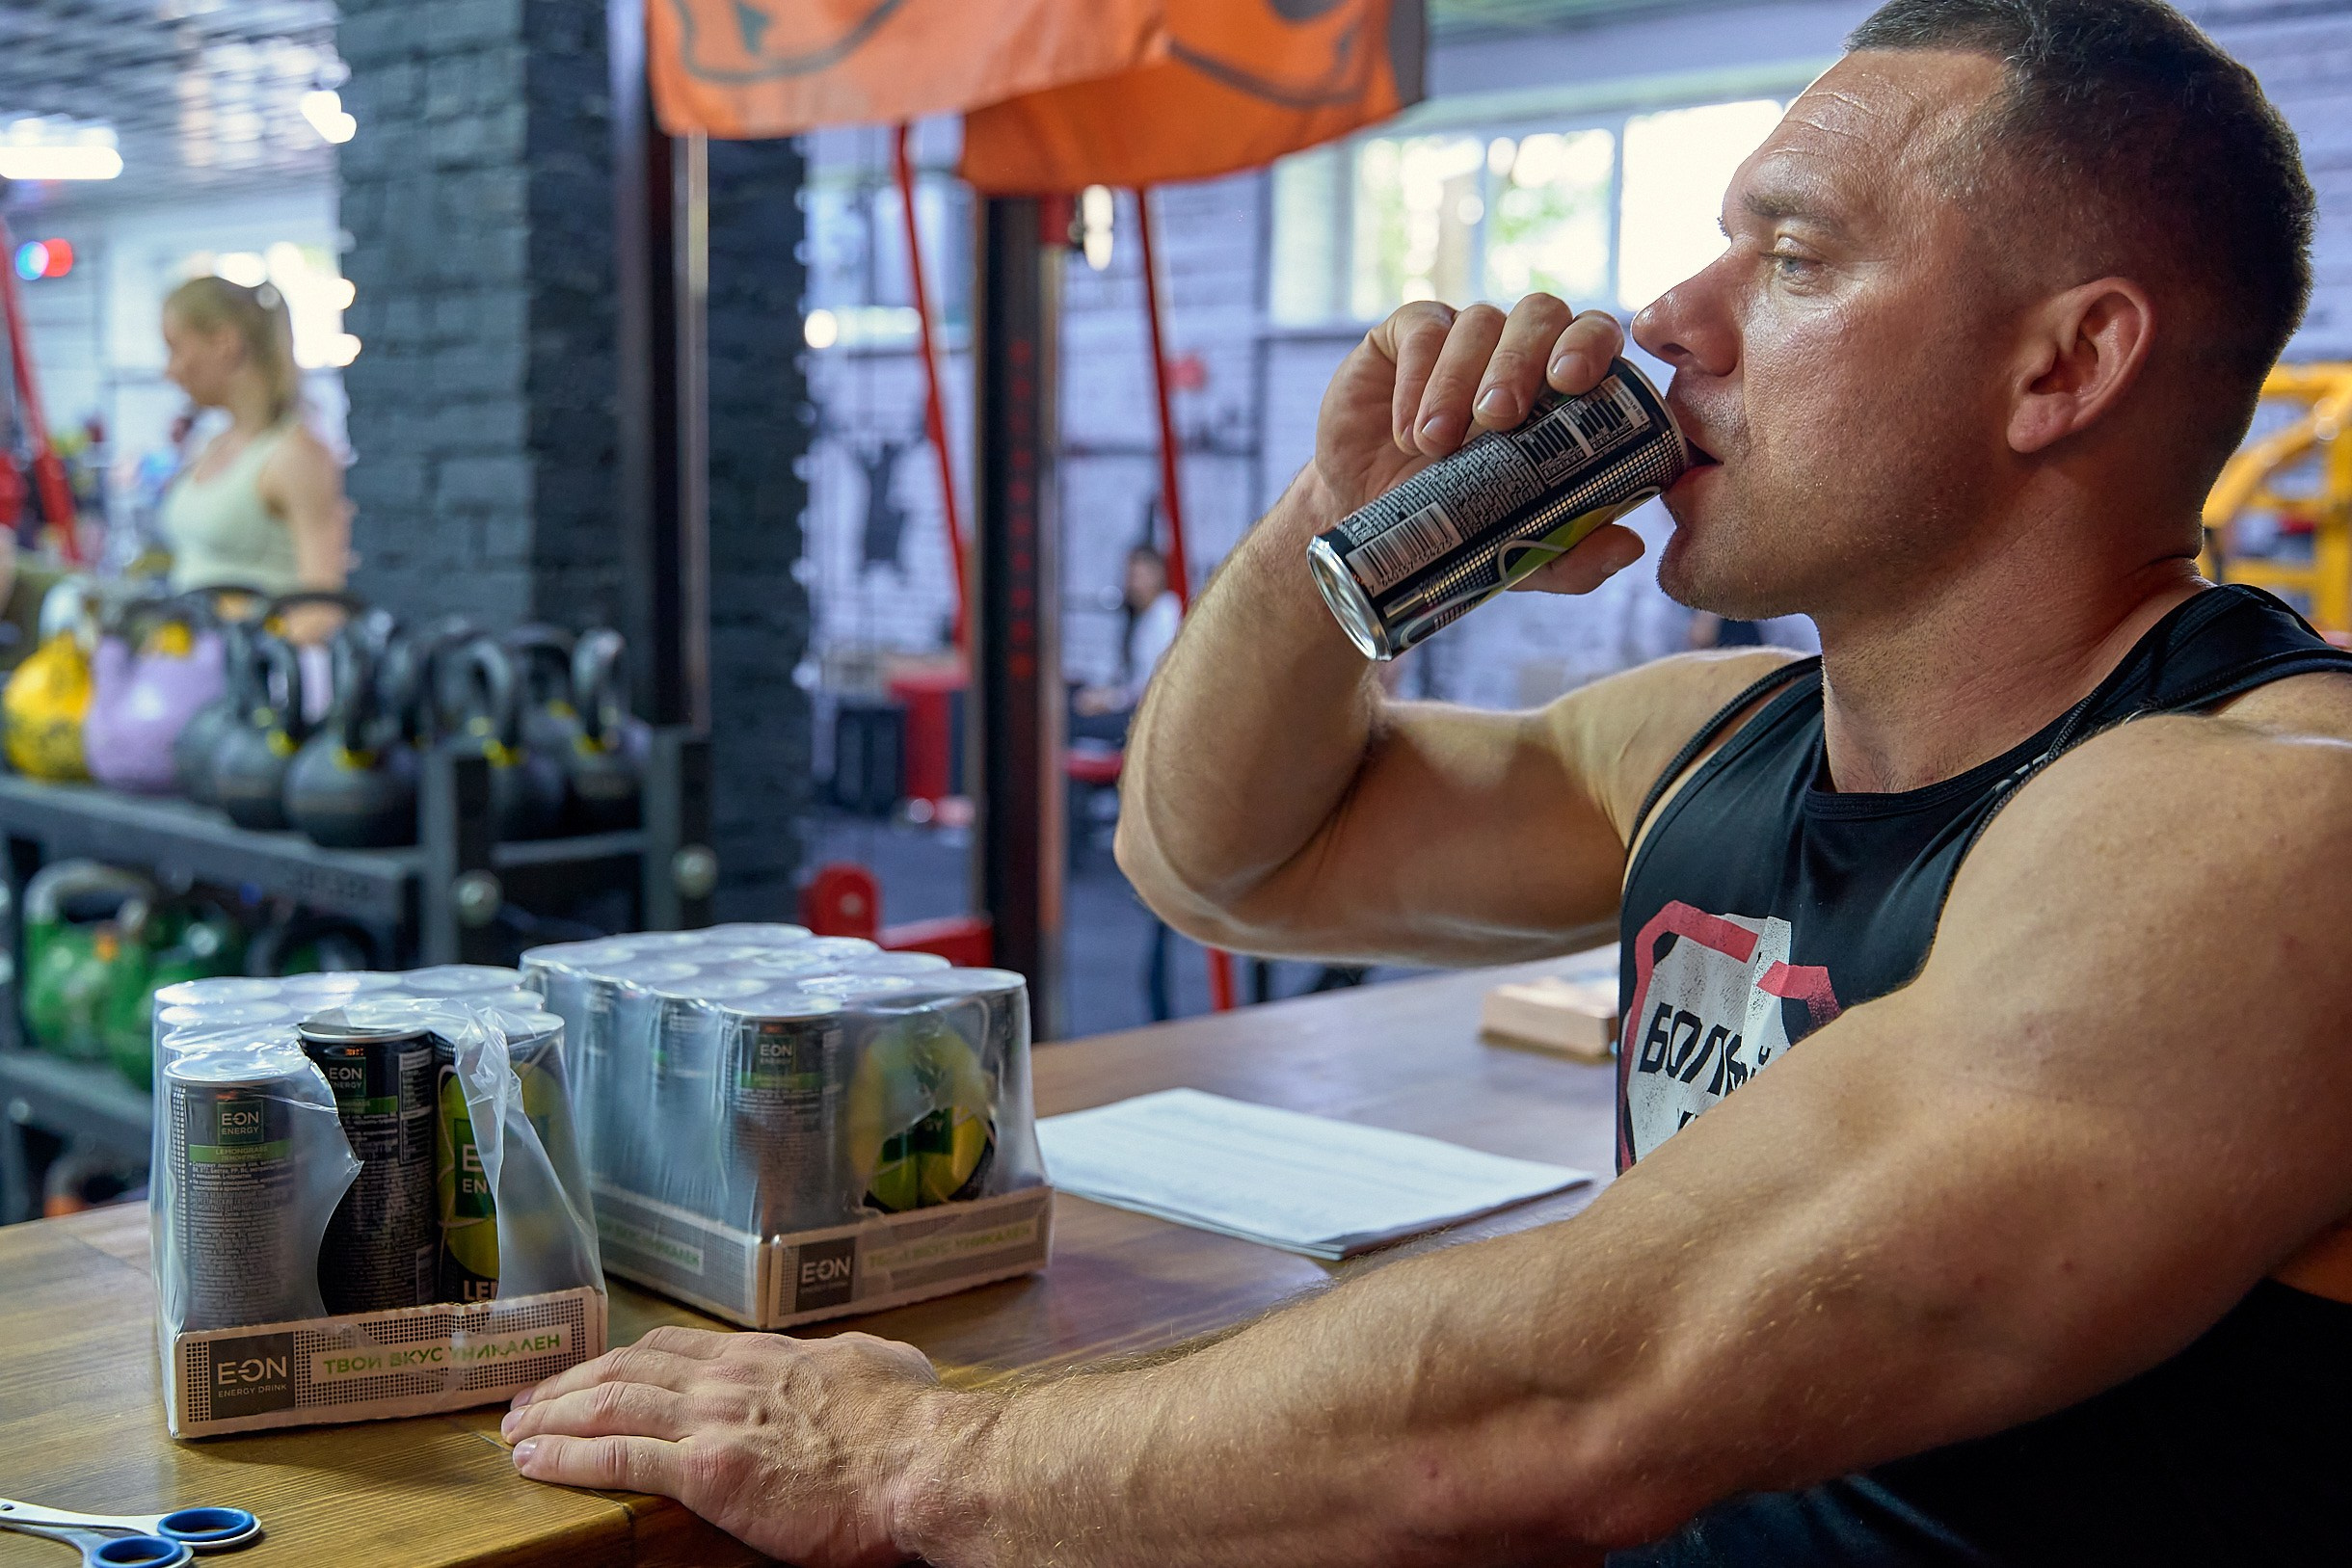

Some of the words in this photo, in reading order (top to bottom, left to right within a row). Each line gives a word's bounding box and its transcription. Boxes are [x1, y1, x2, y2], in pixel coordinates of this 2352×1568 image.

[329, 1067, 362, 1079] EON
[222, 1111, 259, 1126] EON
[222, 1126, 259, 1135] ENERGY
[801, 1255, 852, 1285] EON
[389, 1346, 442, 1368] ВКУС
[217, 1355, 287, 1385] EON
[218, 1387, 255, 1398] ENERGY
[258, 1384, 287, 1395] DRINK
